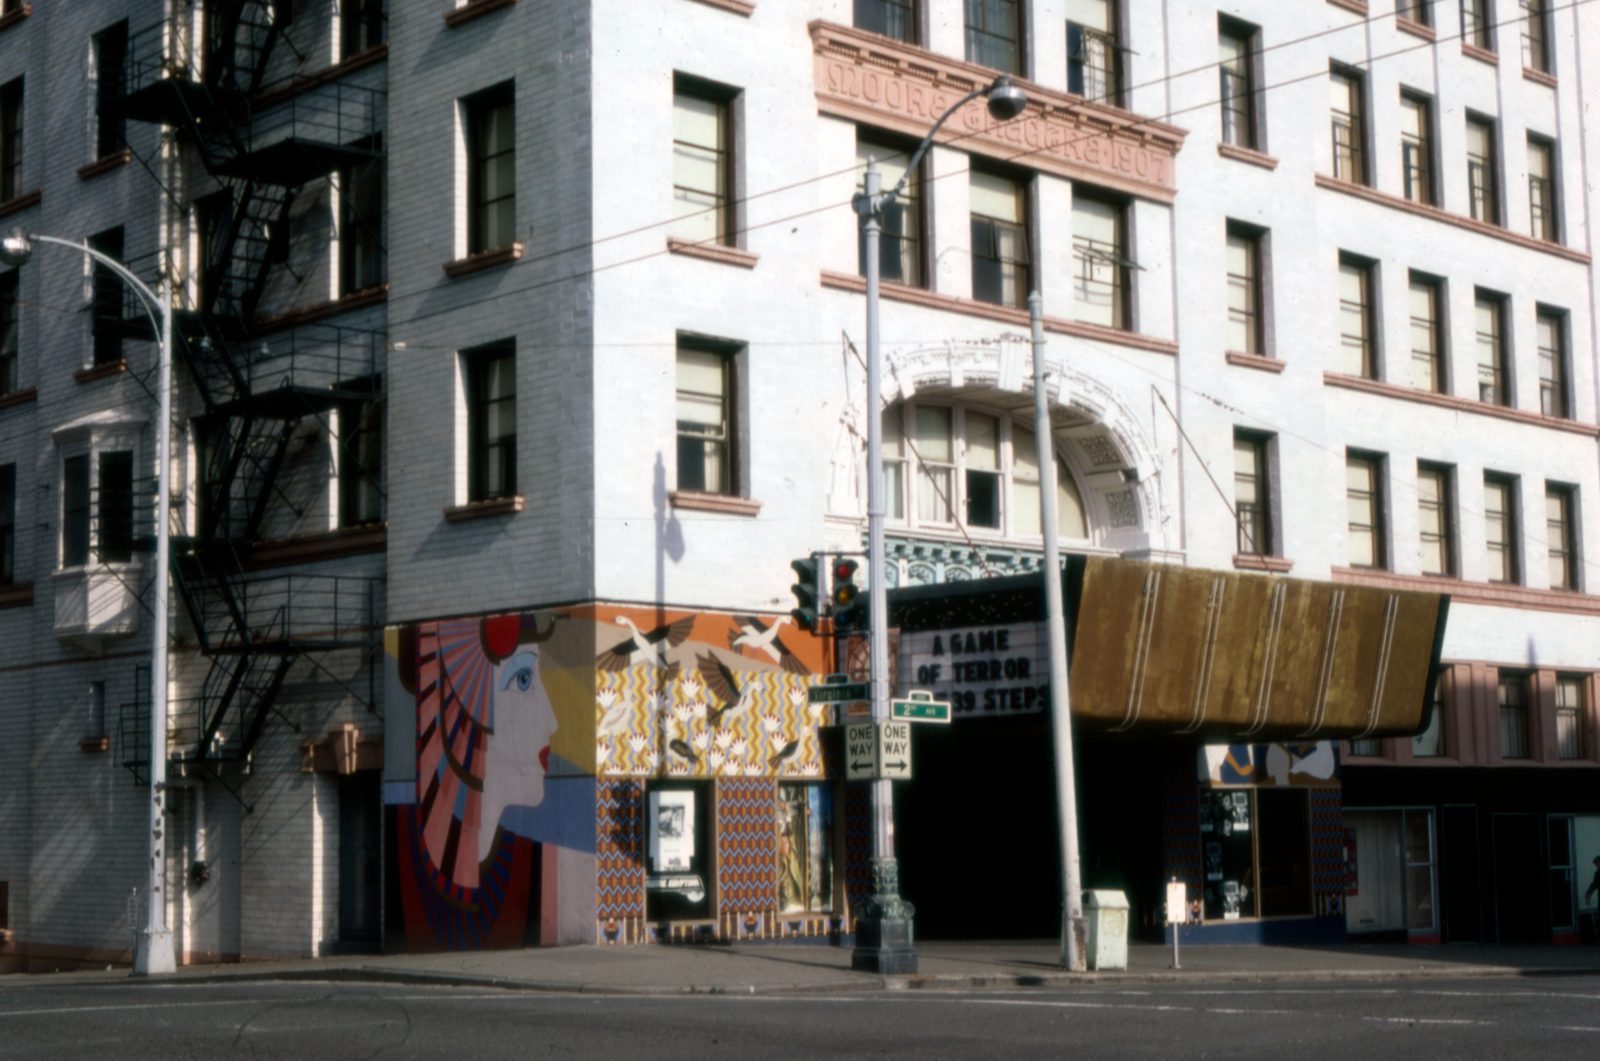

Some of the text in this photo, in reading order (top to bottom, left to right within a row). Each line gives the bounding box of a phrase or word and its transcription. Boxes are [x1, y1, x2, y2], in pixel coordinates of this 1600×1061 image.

[827, 62, 948, 122] MOORE
[1110, 138, 1164, 183] 1907
[932, 629, 1009, 657] A GAME
[917, 657, 1031, 686] OF TERROR
[951, 690, 976, 712] 39
[849, 725, 873, 741] ONE
[884, 724, 907, 740] ONE
[849, 742, 873, 757] WAY
[884, 741, 908, 756] WAY
